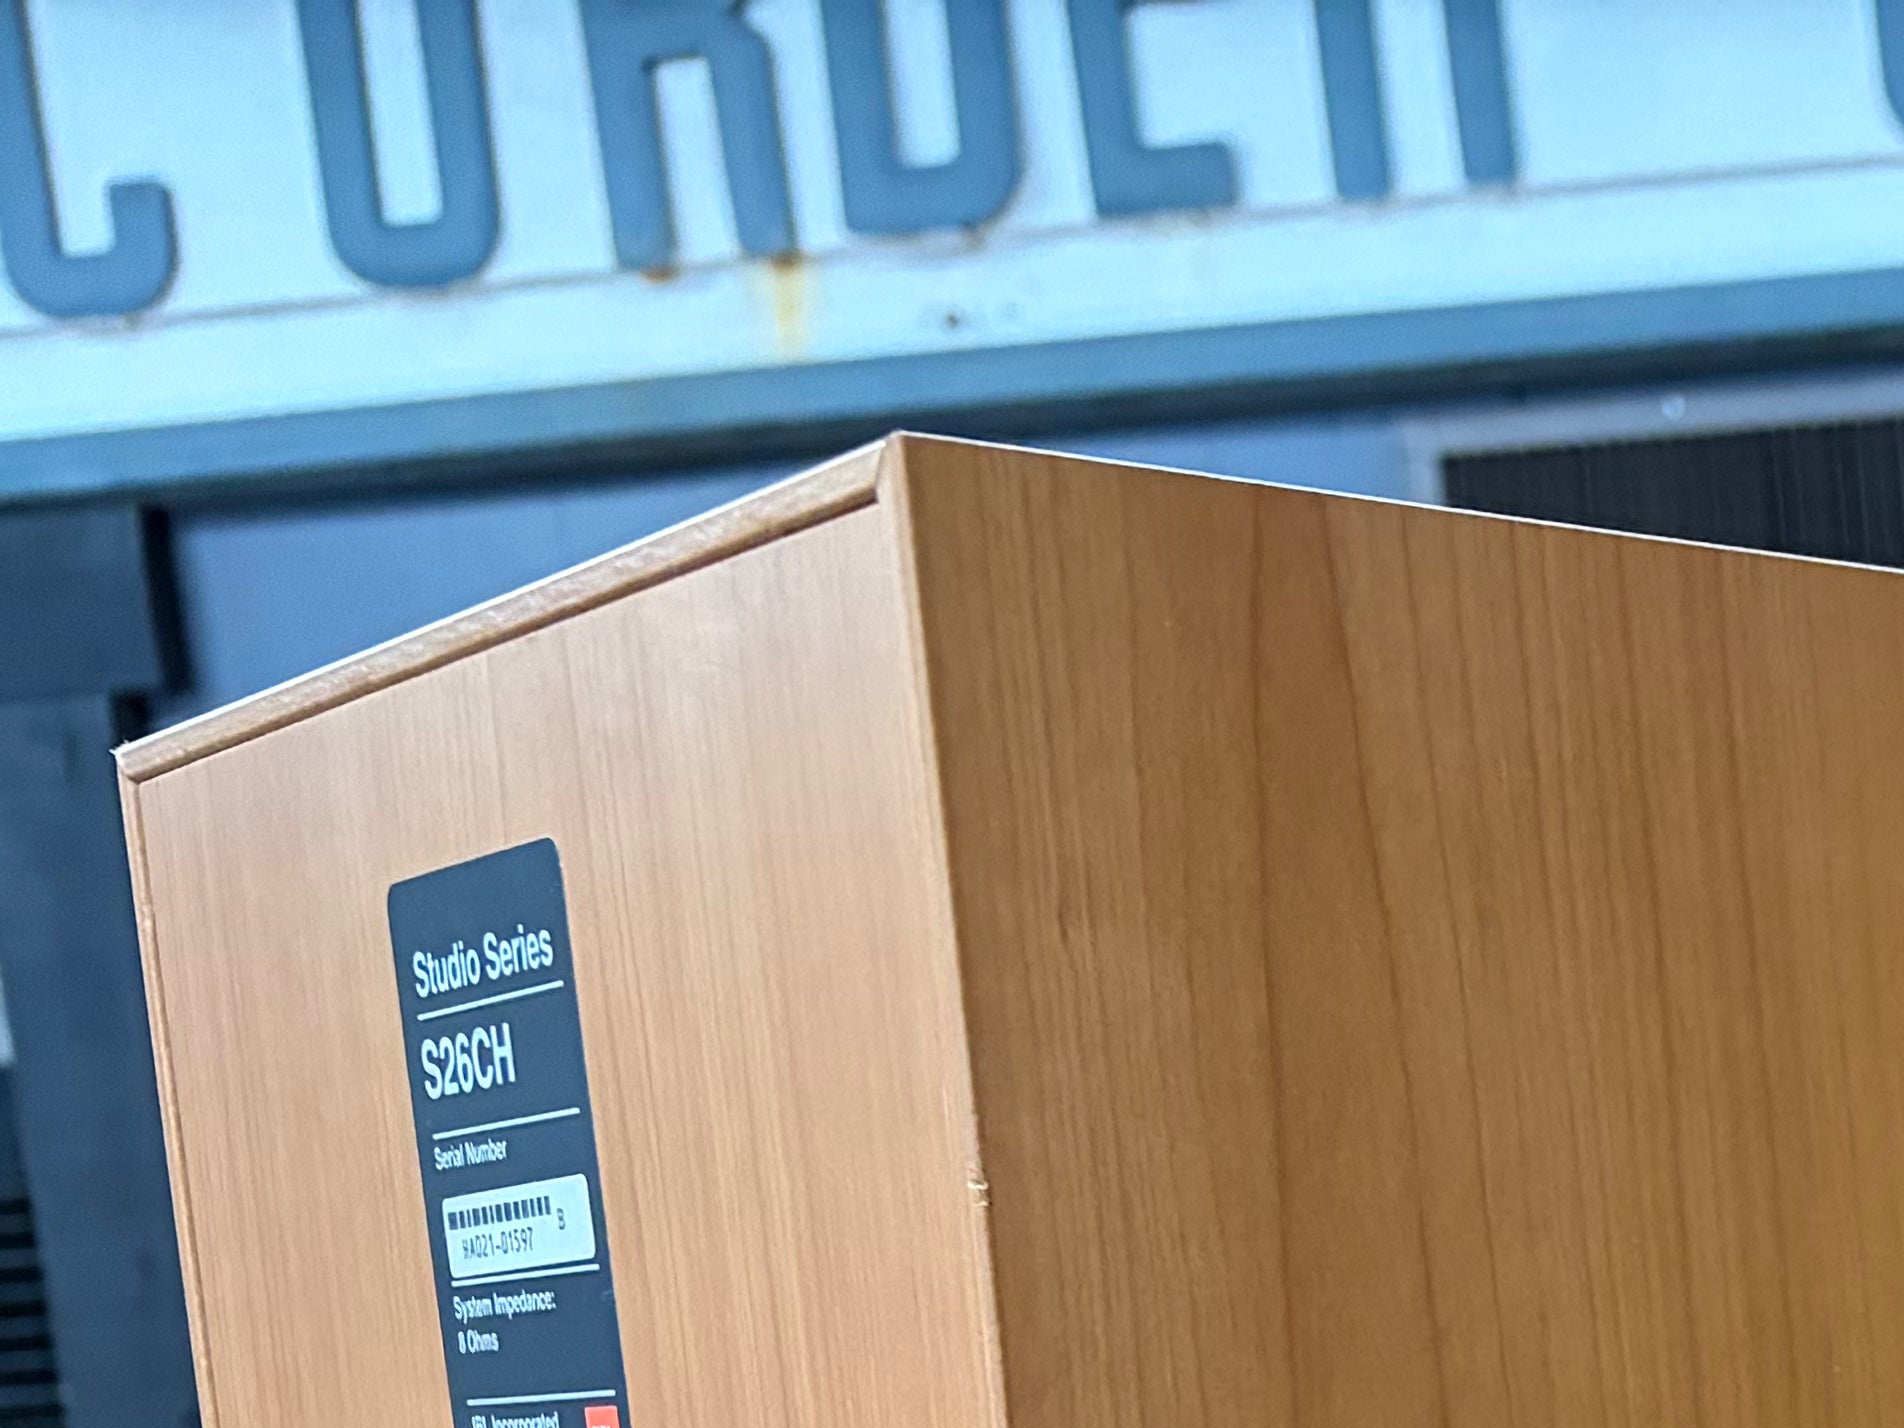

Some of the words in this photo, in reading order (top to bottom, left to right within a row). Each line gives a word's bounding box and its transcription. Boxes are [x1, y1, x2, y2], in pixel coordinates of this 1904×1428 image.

[412, 940, 481, 998] Studio
[483, 924, 553, 980] Series
[421, 1022, 516, 1100] S26CH
[434, 1144, 465, 1171] Serial
[465, 1138, 508, 1165] Number
[453, 1295, 493, 1325] System
[493, 1288, 557, 1320] Impedance:
[467, 1328, 499, 1354] Ohms
